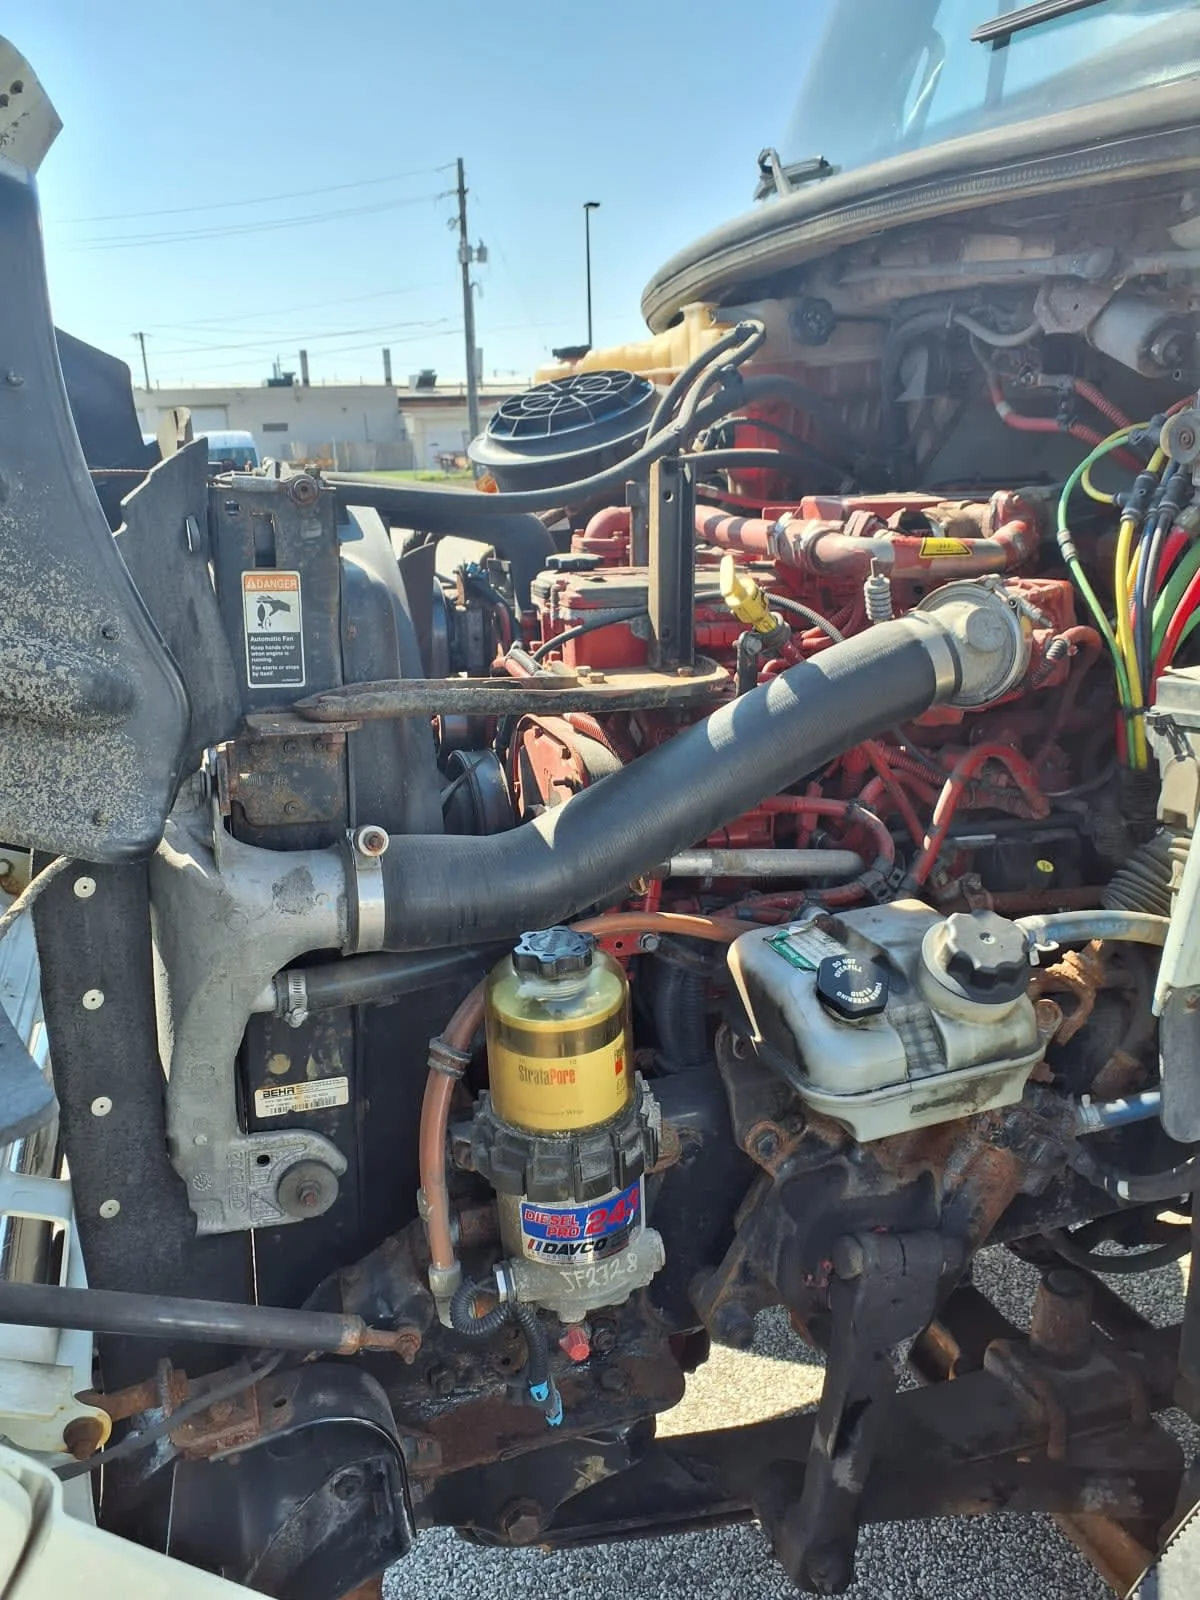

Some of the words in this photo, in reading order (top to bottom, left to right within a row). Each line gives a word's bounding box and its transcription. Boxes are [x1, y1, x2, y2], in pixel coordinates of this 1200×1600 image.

[256, 579, 297, 589] DANGER
[832, 960, 842, 968] DO
[834, 964, 863, 978] OVERFILL
[836, 991, 870, 1004] STEERING
[850, 987, 872, 998] FLUID
[869, 982, 883, 1001] POWER
[518, 1064, 577, 1087] StrataPore
[262, 1086, 295, 1099] BEHR
[524, 1208, 580, 1226] DIESEL
[546, 1224, 582, 1239] PRO
[543, 1237, 608, 1256] DAVCO
